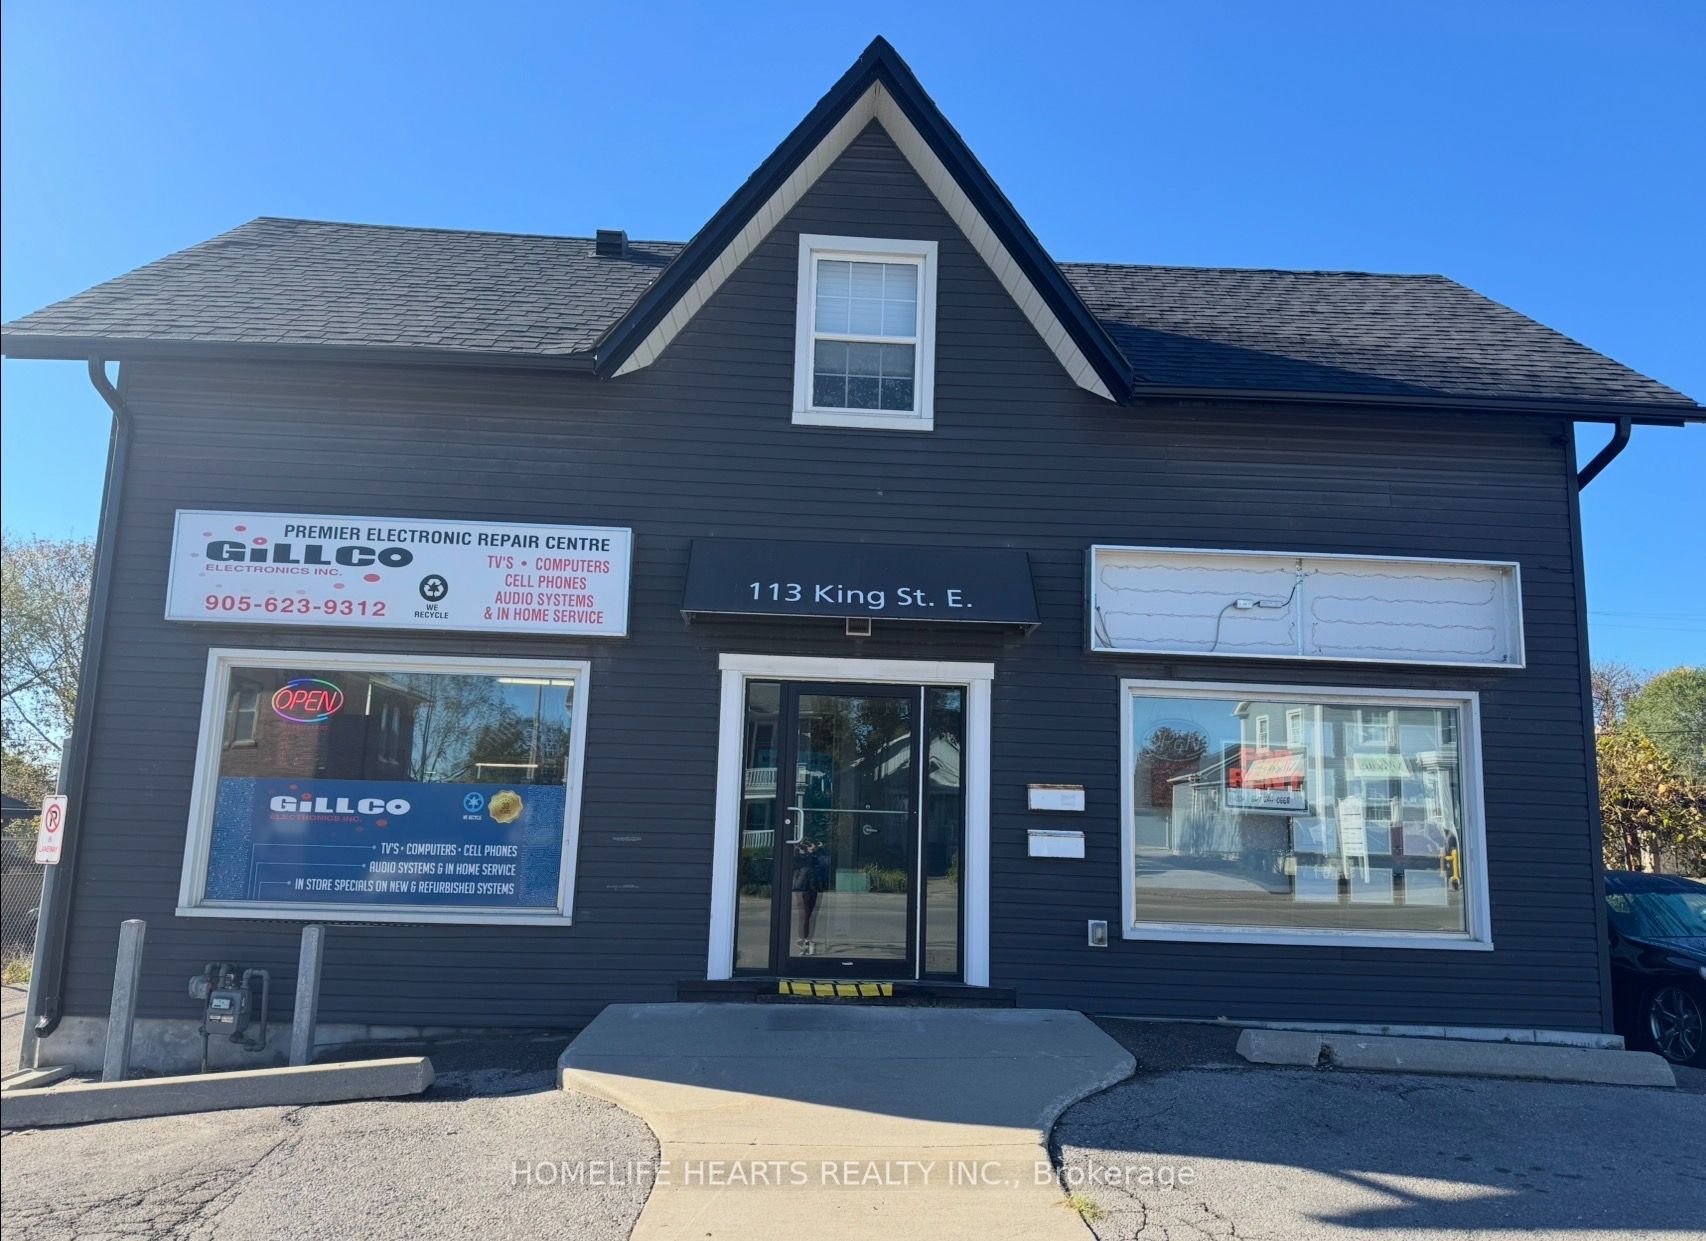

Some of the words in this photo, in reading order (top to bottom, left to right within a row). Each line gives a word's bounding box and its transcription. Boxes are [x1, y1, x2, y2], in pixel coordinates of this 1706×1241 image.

[284, 524, 360, 541] PREMIER
[367, 528, 472, 545] ELECTRONIC
[477, 532, 540, 549] REPAIR
[545, 536, 611, 552] CENTRE
[205, 564, 310, 575] ELECTRONICS
[314, 568, 343, 576] INC.
[487, 555, 514, 569] TV'S
[535, 557, 610, 574] COMPUTERS
[505, 573, 534, 588] CELL
[538, 575, 587, 590] PHONES
[495, 591, 533, 606] AUDIO
[537, 592, 594, 608] SYSTEMS
[750, 582, 802, 602] 113
[814, 584, 886, 610] King
[897, 587, 935, 607] St.
[946, 589, 973, 608] E.
[205, 595, 386, 617] 905-623-9312
[414, 611, 449, 619] RECYCLE
[484, 606, 493, 620] &
[497, 607, 509, 621] IN
[513, 607, 549, 622] HOME
[553, 609, 604, 624] SERVICE
[275, 689, 338, 712] OPEN
[269, 814, 341, 822] ELECTRONICS
[380, 842, 400, 855] TV'S
[406, 843, 457, 856] COMPUTERS
[463, 844, 482, 857] CELL
[484, 845, 518, 857] PHONES
[369, 861, 396, 874] AUDIO
[398, 861, 436, 875] SYSTEMS
[437, 863, 444, 875] &
[445, 863, 454, 875] IN
[456, 863, 480, 876] HOME
[481, 864, 517, 876] SERVICE
[295, 878, 305, 890] IN
[305, 878, 333, 891] STORE
[334, 879, 374, 892] SPECIALS
[375, 880, 388, 893] ON
[389, 880, 409, 893] NEW
[410, 881, 417, 893] &
[420, 881, 475, 894] REFURBISHED
[476, 882, 515, 895] SYSTEMS
